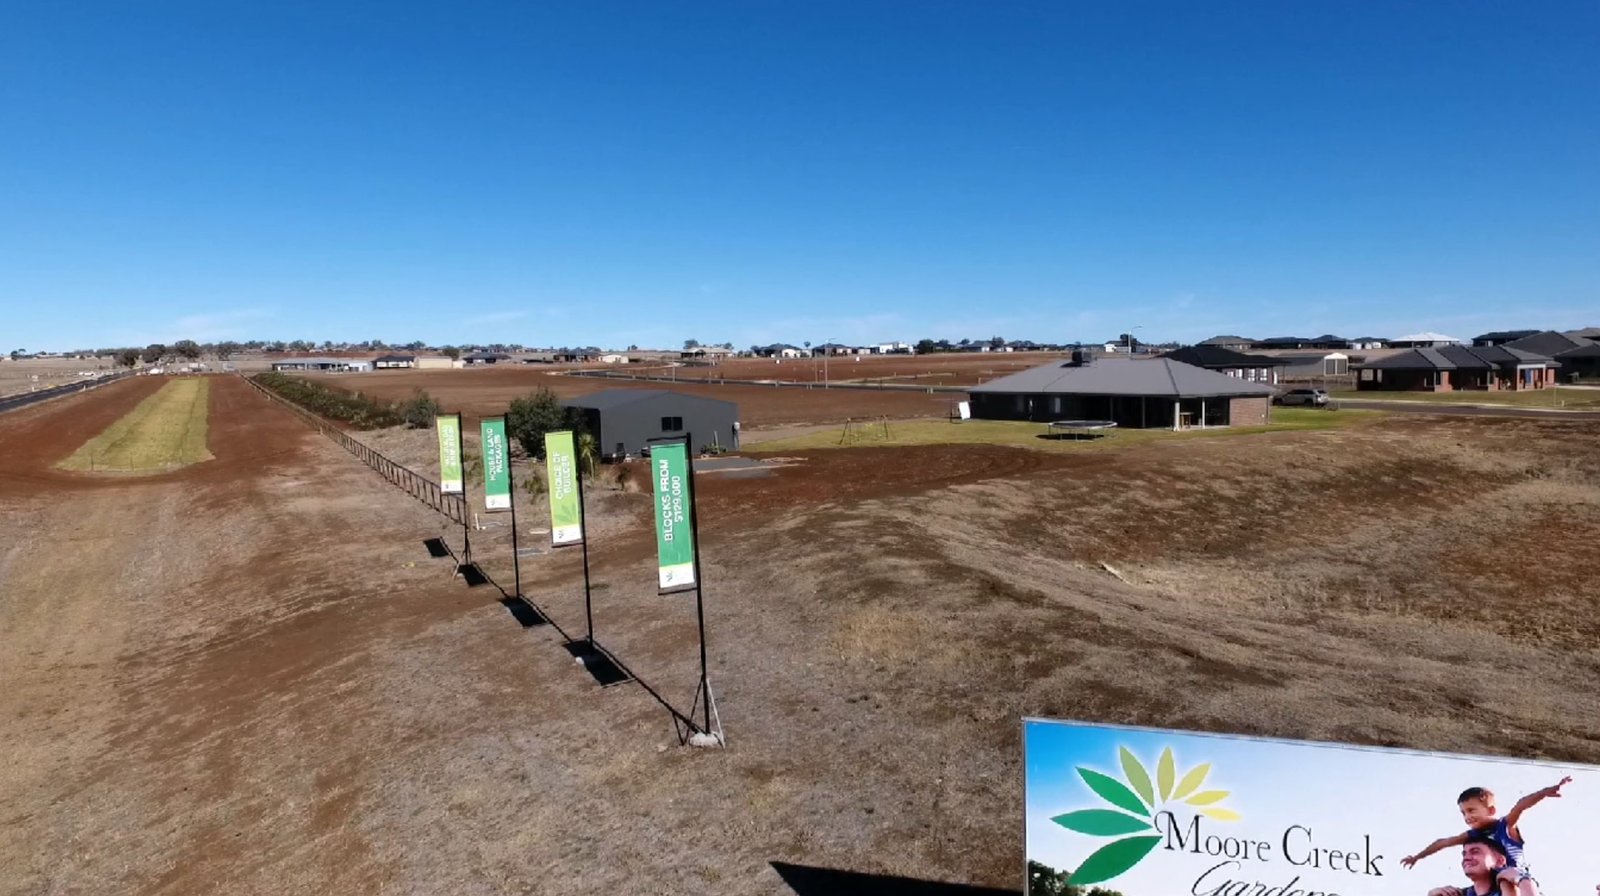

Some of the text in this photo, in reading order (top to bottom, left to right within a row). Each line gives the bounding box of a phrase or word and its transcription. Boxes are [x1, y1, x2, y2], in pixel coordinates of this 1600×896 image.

[486, 428, 494, 448] LAND
[488, 456, 497, 481] HOUSE
[552, 451, 563, 500] CHOICE OF
[561, 455, 571, 493] BUILDER
[659, 459, 673, 541] BLOCKS FROM
[1154, 810, 1384, 876] Moore Creek
